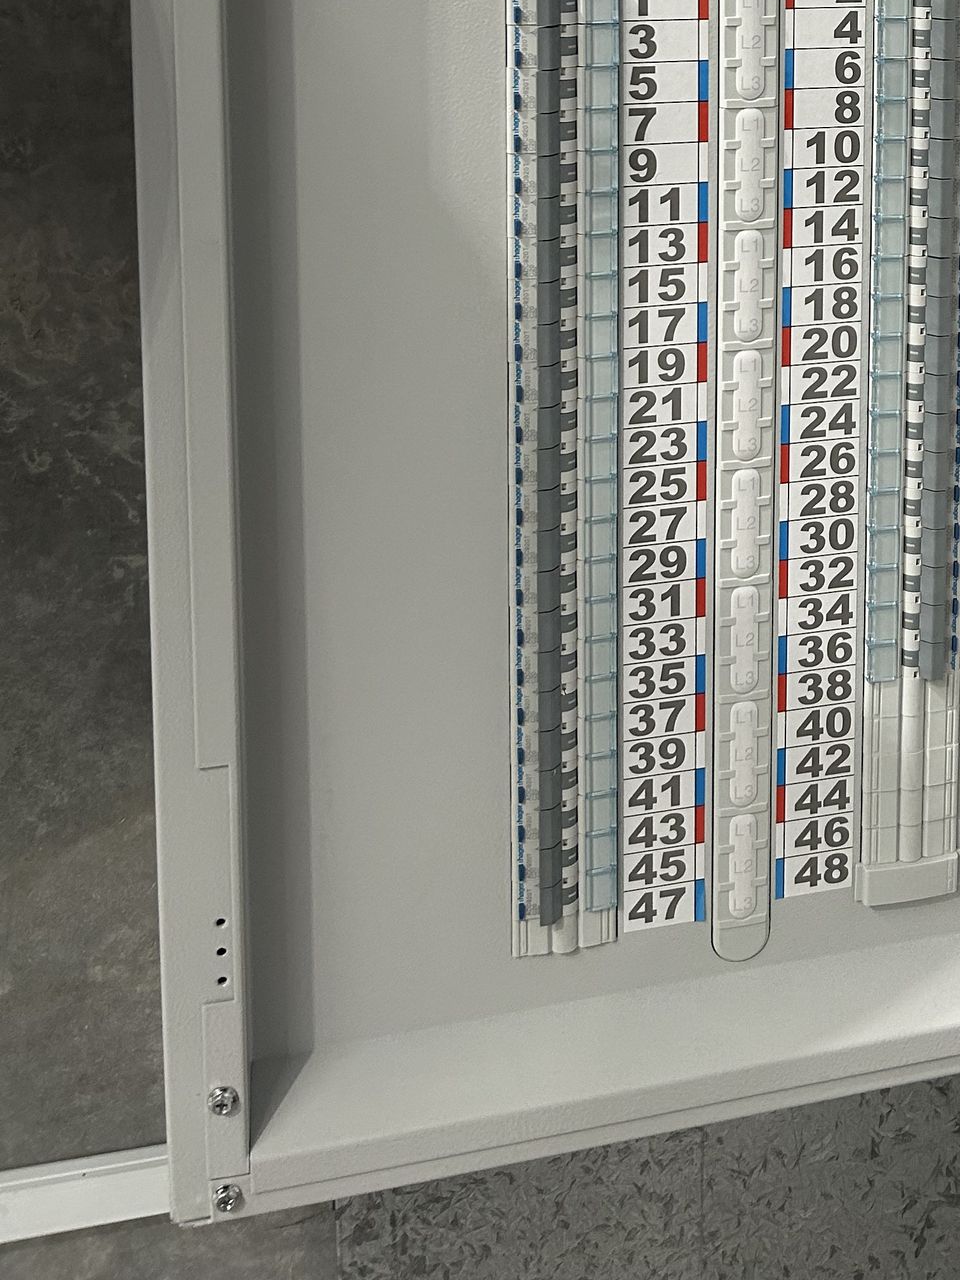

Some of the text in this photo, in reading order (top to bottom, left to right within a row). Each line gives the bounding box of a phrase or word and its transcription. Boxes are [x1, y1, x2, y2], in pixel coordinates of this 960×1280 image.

[629, 25, 656, 59] 3
[742, 36, 760, 50] L2
[834, 11, 861, 43] 4
[629, 66, 657, 100] 5
[741, 77, 759, 91] L3
[835, 51, 861, 84] 6
[835, 91, 860, 123] 8
[629, 108, 656, 141] 7
[742, 119, 759, 132] L1
[807, 130, 860, 164] 10
[629, 149, 656, 182] 9
[741, 158, 760, 172] L2
[807, 170, 859, 203] 12
[629, 188, 679, 223] 11
[741, 199, 759, 212] L3
[805, 209, 859, 243] 14
[629, 228, 685, 263] 13
[741, 239, 758, 252] L1
[805, 248, 858, 281] 16
[629, 268, 685, 303] 15
[740, 279, 758, 293] L2
[805, 287, 857, 320] 18
[629, 308, 685, 344] 17
[739, 320, 758, 333] L3
[802, 326, 857, 361] 20
[629, 348, 685, 383] 19
[740, 360, 756, 373] L1
[802, 365, 856, 400] 22
[629, 388, 681, 424] 21
[739, 399, 757, 412] L2
[800, 403, 856, 439] 24
[629, 428, 687, 464] 23
[738, 439, 756, 452] L3
[800, 442, 855, 478] 26
[629, 467, 687, 504] 25
[800, 481, 854, 516] 28
[629, 507, 687, 544] 27
[800, 519, 854, 553] 30
[629, 546, 686, 582] 29
[800, 557, 853, 592] 32
[629, 584, 680, 621] 31
[798, 594, 853, 630] 34
[629, 624, 686, 660] 33
[798, 632, 852, 667] 36
[629, 662, 685, 698] 35
[798, 670, 851, 705] 38
[629, 699, 685, 736] 37
[797, 707, 851, 741] 40
[629, 738, 685, 774] 39
[796, 744, 850, 777] 42
[629, 775, 680, 810] 41
[795, 780, 850, 814] 44
[629, 813, 686, 848] 43
[795, 817, 849, 850] 46
[629, 849, 686, 885] 45
[795, 853, 848, 887] 48
[629, 887, 685, 923] 47
